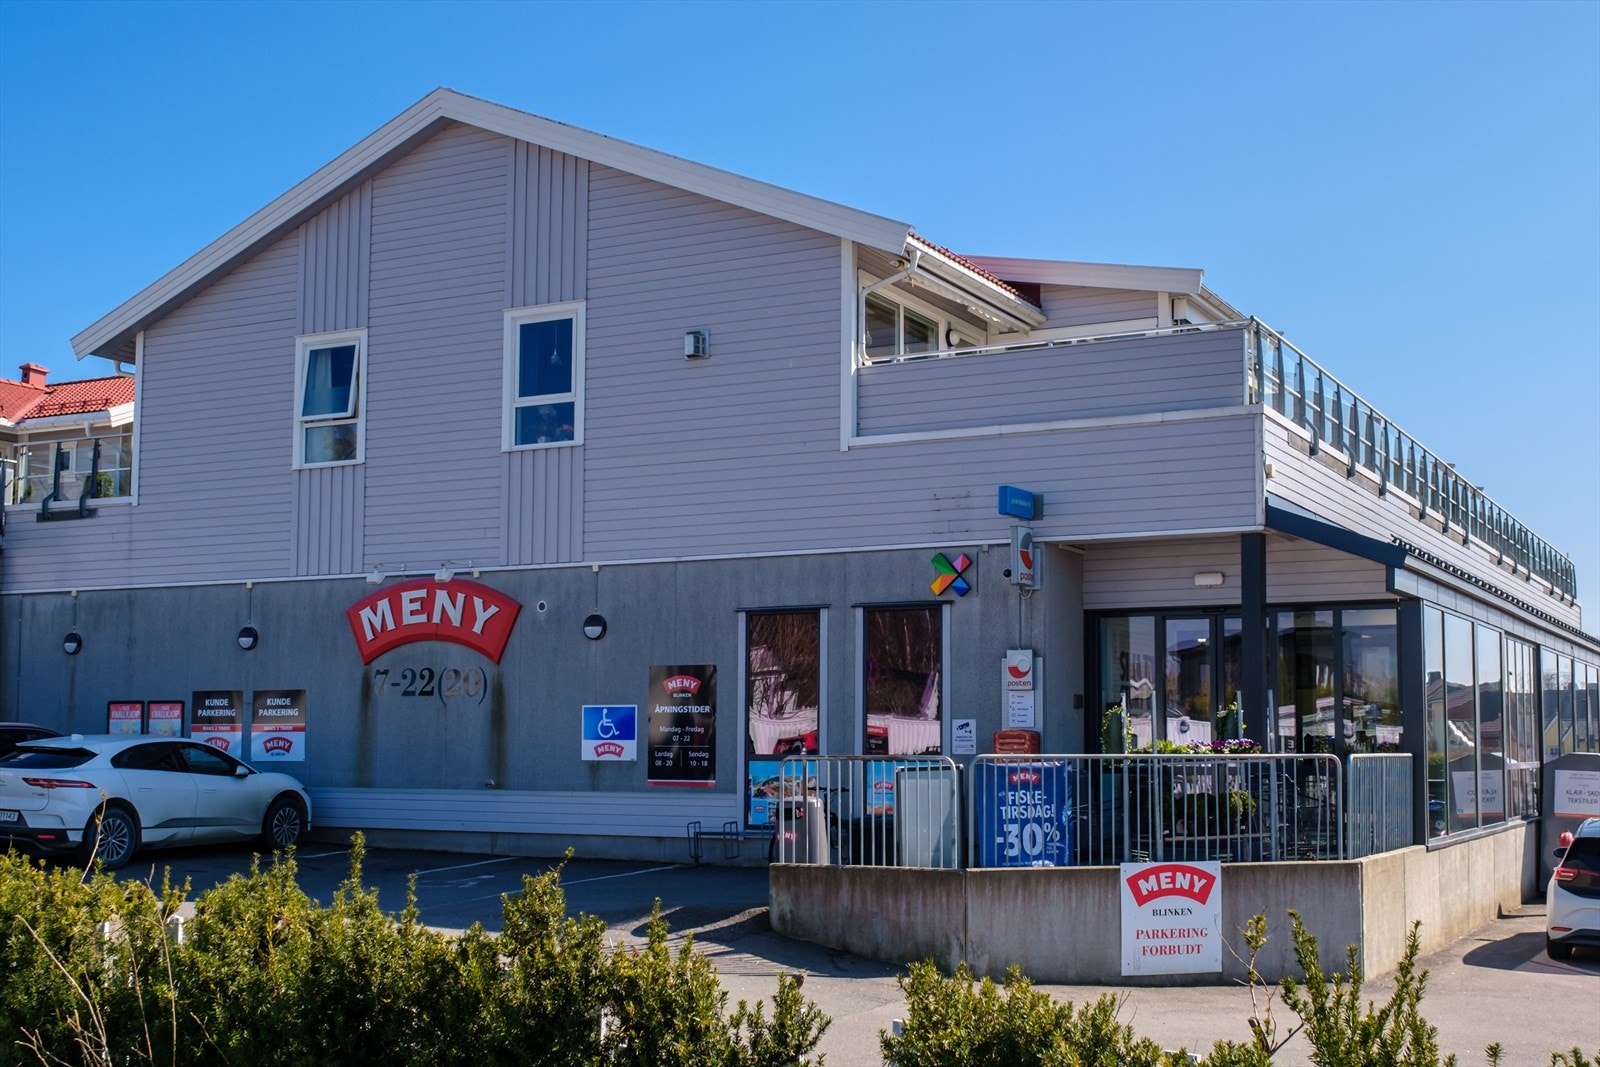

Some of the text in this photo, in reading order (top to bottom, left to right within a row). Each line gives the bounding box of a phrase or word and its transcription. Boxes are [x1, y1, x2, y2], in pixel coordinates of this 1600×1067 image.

[358, 589, 500, 642] MENY
[374, 667, 488, 706] 7-22(20)
[667, 678, 698, 689] MENY
[205, 698, 229, 707] KUNDE
[266, 697, 291, 706] KUNDE
[197, 708, 236, 717] PARKERING
[258, 708, 299, 717] PARKERING
[654, 704, 711, 713] ÅPNINGSTIDER
[660, 726, 681, 734] Mandag
[685, 726, 705, 734] Fredag
[266, 739, 290, 749] MENY
[597, 744, 622, 753] MENY
[1012, 773, 1037, 782] MENY
[1008, 790, 1047, 804] FISKE-
[1000, 804, 1055, 820] TIRSDAG!
[996, 822, 1060, 857] -30%
[1137, 872, 1207, 896] MENY
[1152, 908, 1193, 916] BLINKEN
[1136, 928, 1208, 940] PARKERING
[1142, 944, 1203, 956] FORBUDT
